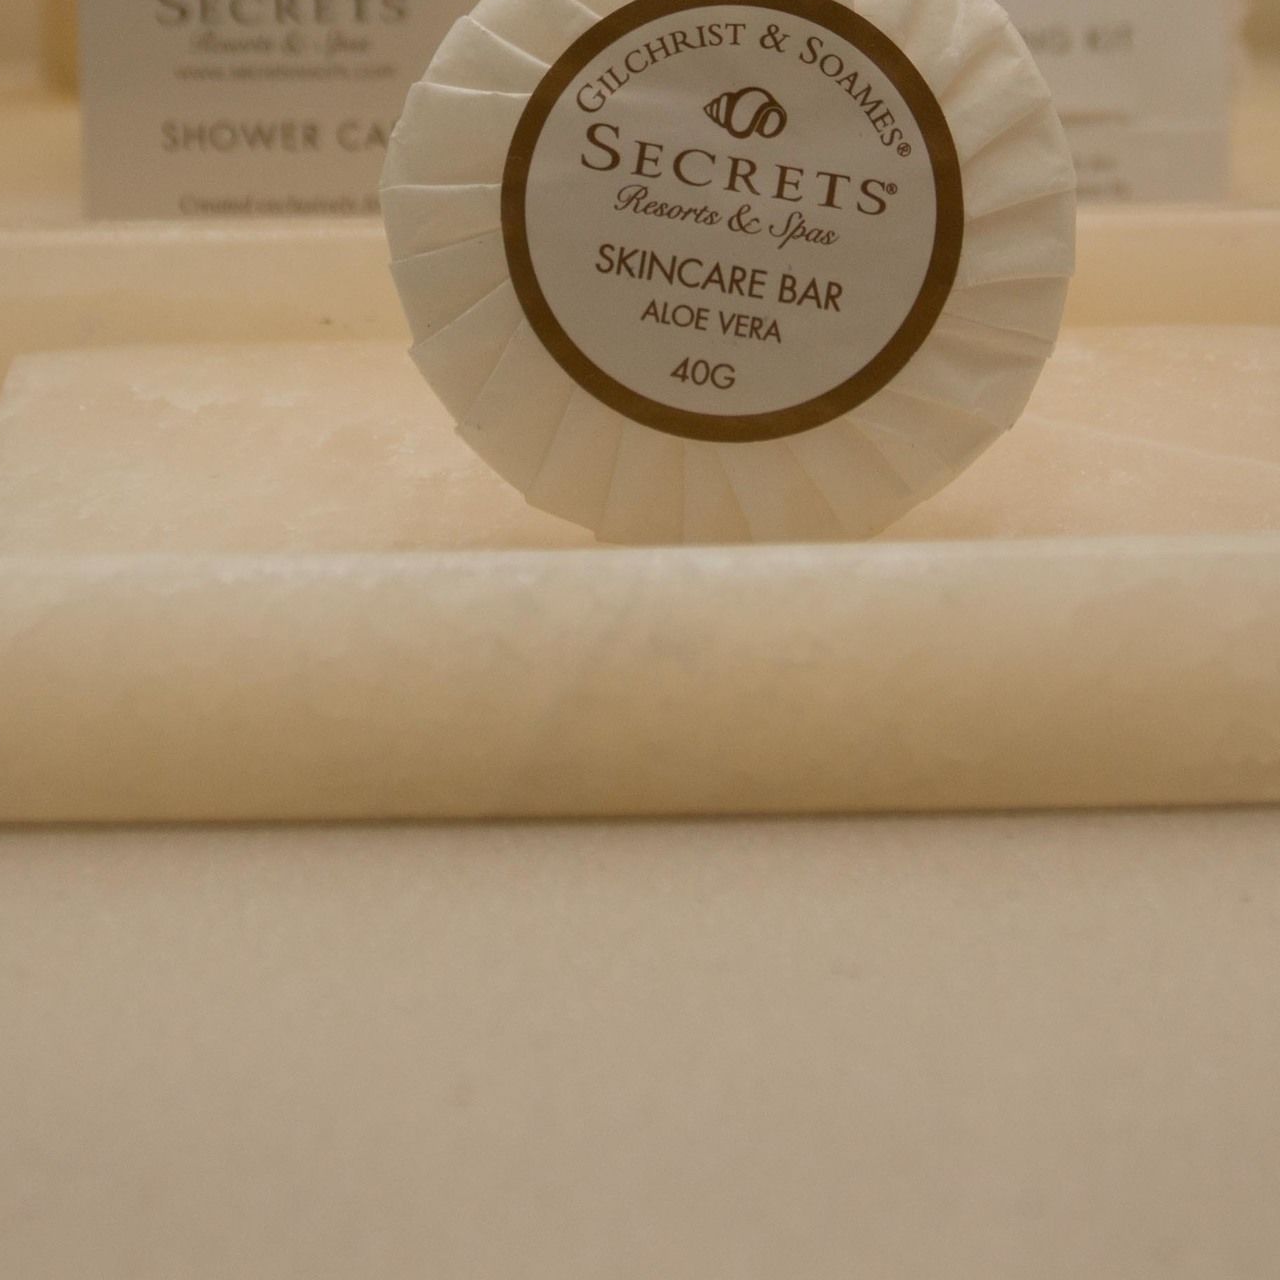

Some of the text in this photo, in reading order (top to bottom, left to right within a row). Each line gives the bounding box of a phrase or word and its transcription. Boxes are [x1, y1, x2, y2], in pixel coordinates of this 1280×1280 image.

[576, 23, 747, 114] GILCHRIST
[759, 23, 791, 54] &
[161, 120, 400, 153] SHOWER CA
[613, 184, 840, 250] Resorts & Spas
[594, 243, 844, 313] SKINCARE BAR
[639, 298, 782, 345] ALOE VERA
[669, 356, 736, 391] 40G
